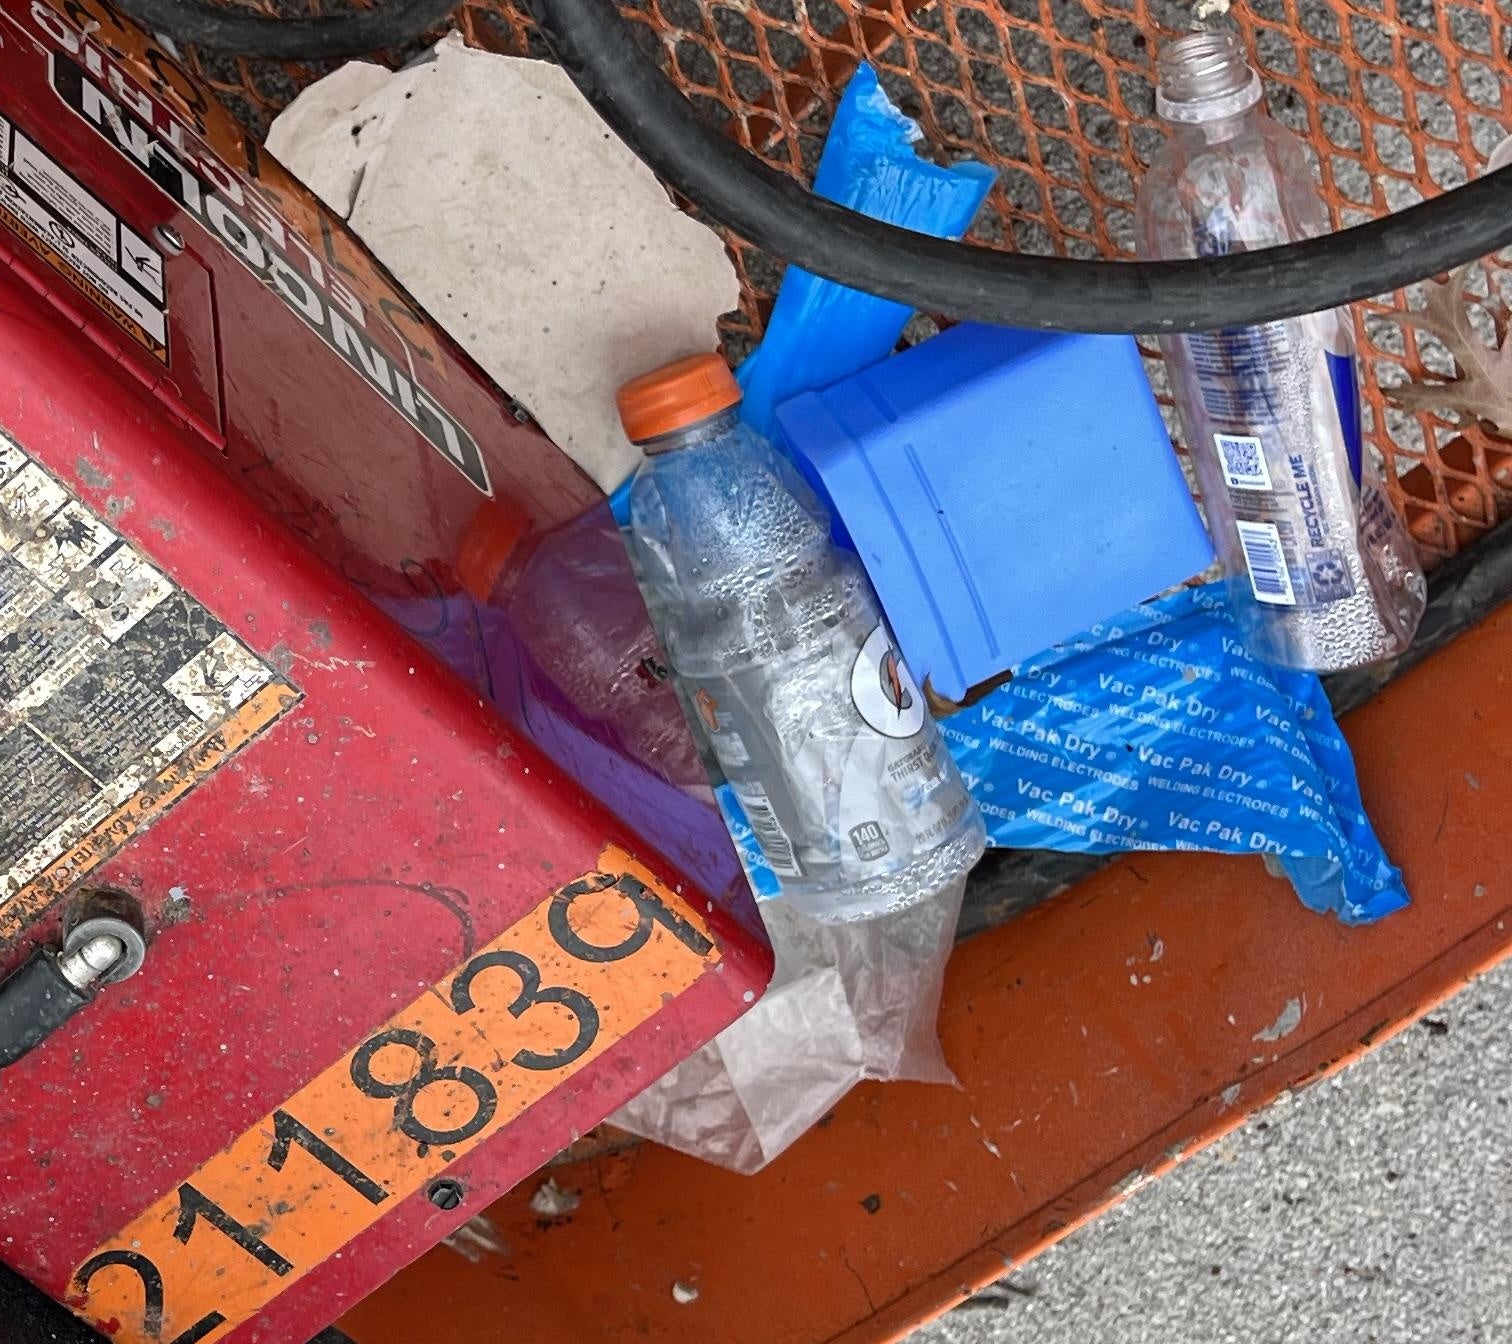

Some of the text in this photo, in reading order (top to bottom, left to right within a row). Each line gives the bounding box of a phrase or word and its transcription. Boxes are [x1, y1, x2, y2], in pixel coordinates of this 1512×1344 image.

[30, 0, 367, 327] ELECTRIC
[81, 78, 467, 466] LINCOLN
[58, 258, 136, 337] WARNING
[1288, 452, 1324, 547] RECYCLE ME
[1133, 648, 1222, 683] ELECTRODES
[1146, 629, 1184, 654] Dry
[1026, 663, 1063, 689] Dry
[1095, 672, 1221, 725] Vac Pak Dry
[1012, 684, 1101, 720] ELECTRODES
[1252, 704, 1294, 733] Vac
[978, 704, 1103, 762] Vac Pak Dry
[1106, 702, 1255, 754] WELDING ELECTRODES
[889, 756, 926, 784] THIRST
[986, 735, 1141, 792] WELDING ELECTRODES
[1135, 743, 1253, 791] Vac Pak Dry
[1013, 777, 1139, 832] Vac Pak Dry
[1147, 772, 1290, 820] WELDING ELECTRODES
[1286, 774, 1327, 805] Vac
[851, 823, 880, 846] 140
[1023, 806, 1088, 838] WELDING
[1166, 809, 1202, 834] Vac
[1204, 819, 1244, 845] Pak
[1247, 830, 1288, 857] Dry
